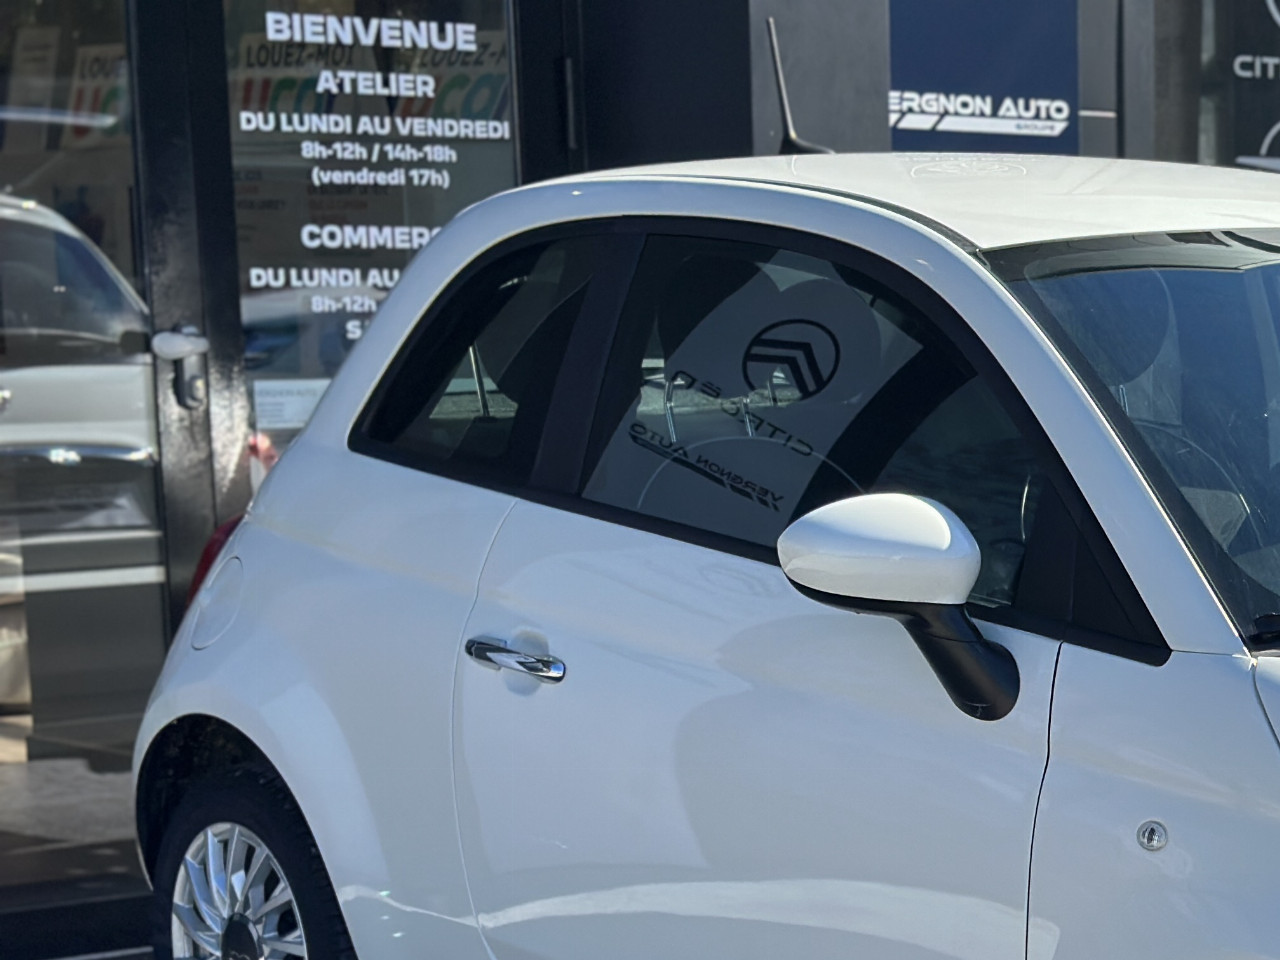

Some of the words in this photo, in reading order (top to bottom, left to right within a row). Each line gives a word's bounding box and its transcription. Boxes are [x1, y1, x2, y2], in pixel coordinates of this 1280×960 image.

[265, 11, 478, 51] BIENVENUE
[316, 70, 436, 98] ATELIER
[997, 97, 1070, 120] AUTO
[239, 112, 276, 132] DU
[280, 113, 351, 134] LUNDI
[357, 115, 391, 135] AU
[395, 117, 511, 140] VENDREDI
[300, 140, 368, 161] 8h-12h
[383, 143, 457, 163] 14h-18h
[311, 166, 406, 187] (vendredi
[408, 168, 450, 189] 17h)
[249, 267, 287, 288] DU
[290, 268, 361, 288] LUNDI
[311, 295, 377, 313] 8h-12h
